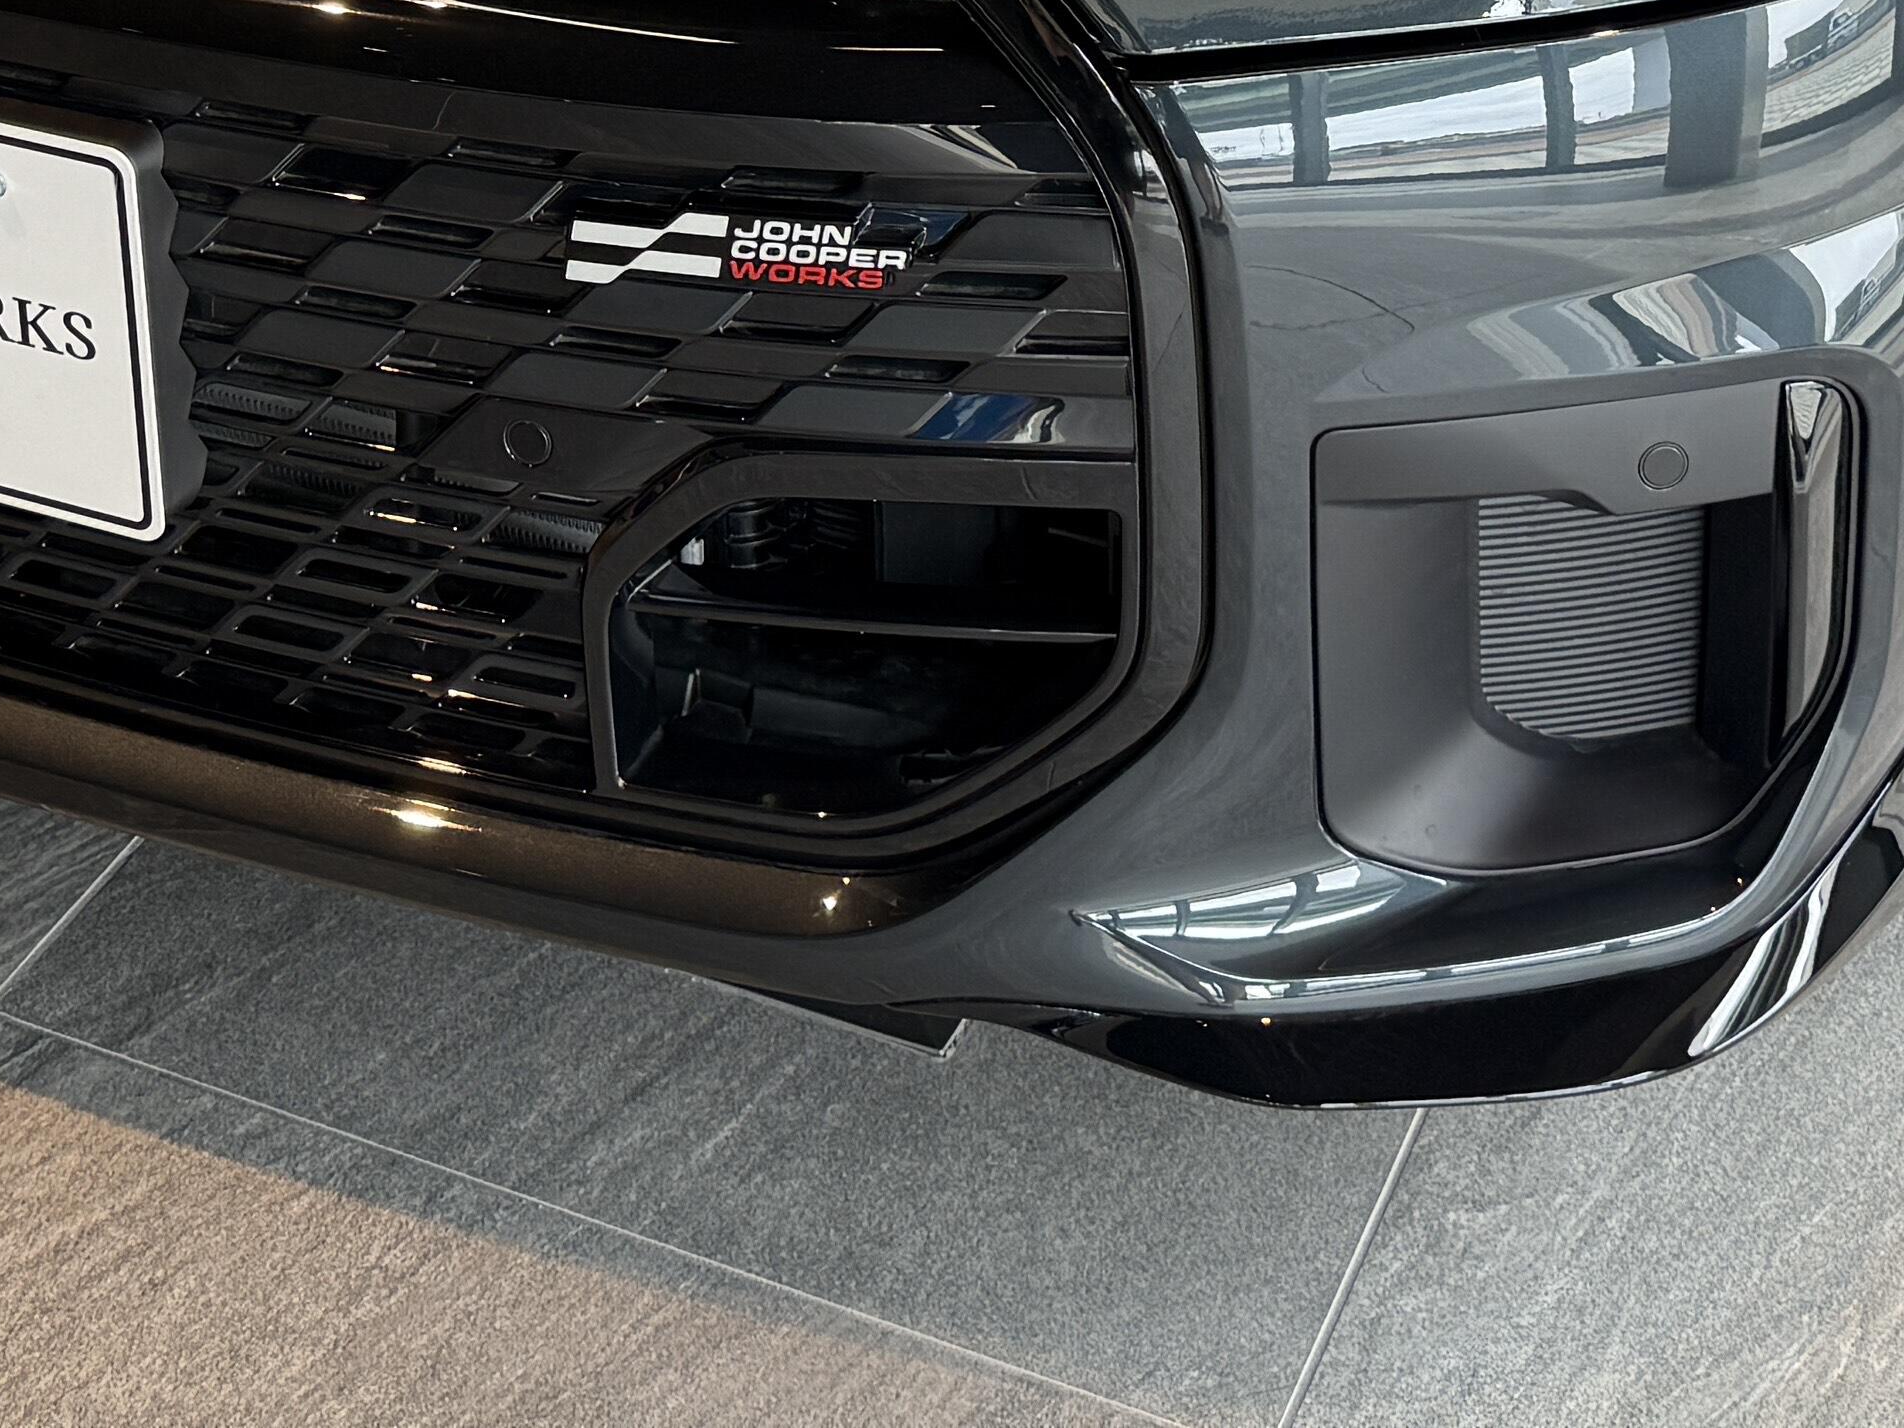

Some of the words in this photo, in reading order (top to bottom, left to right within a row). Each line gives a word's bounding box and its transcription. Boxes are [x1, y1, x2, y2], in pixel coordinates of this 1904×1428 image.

[734, 219, 852, 246] JOHN
[729, 240, 910, 271] COOPER
[729, 260, 885, 289] WORKS
